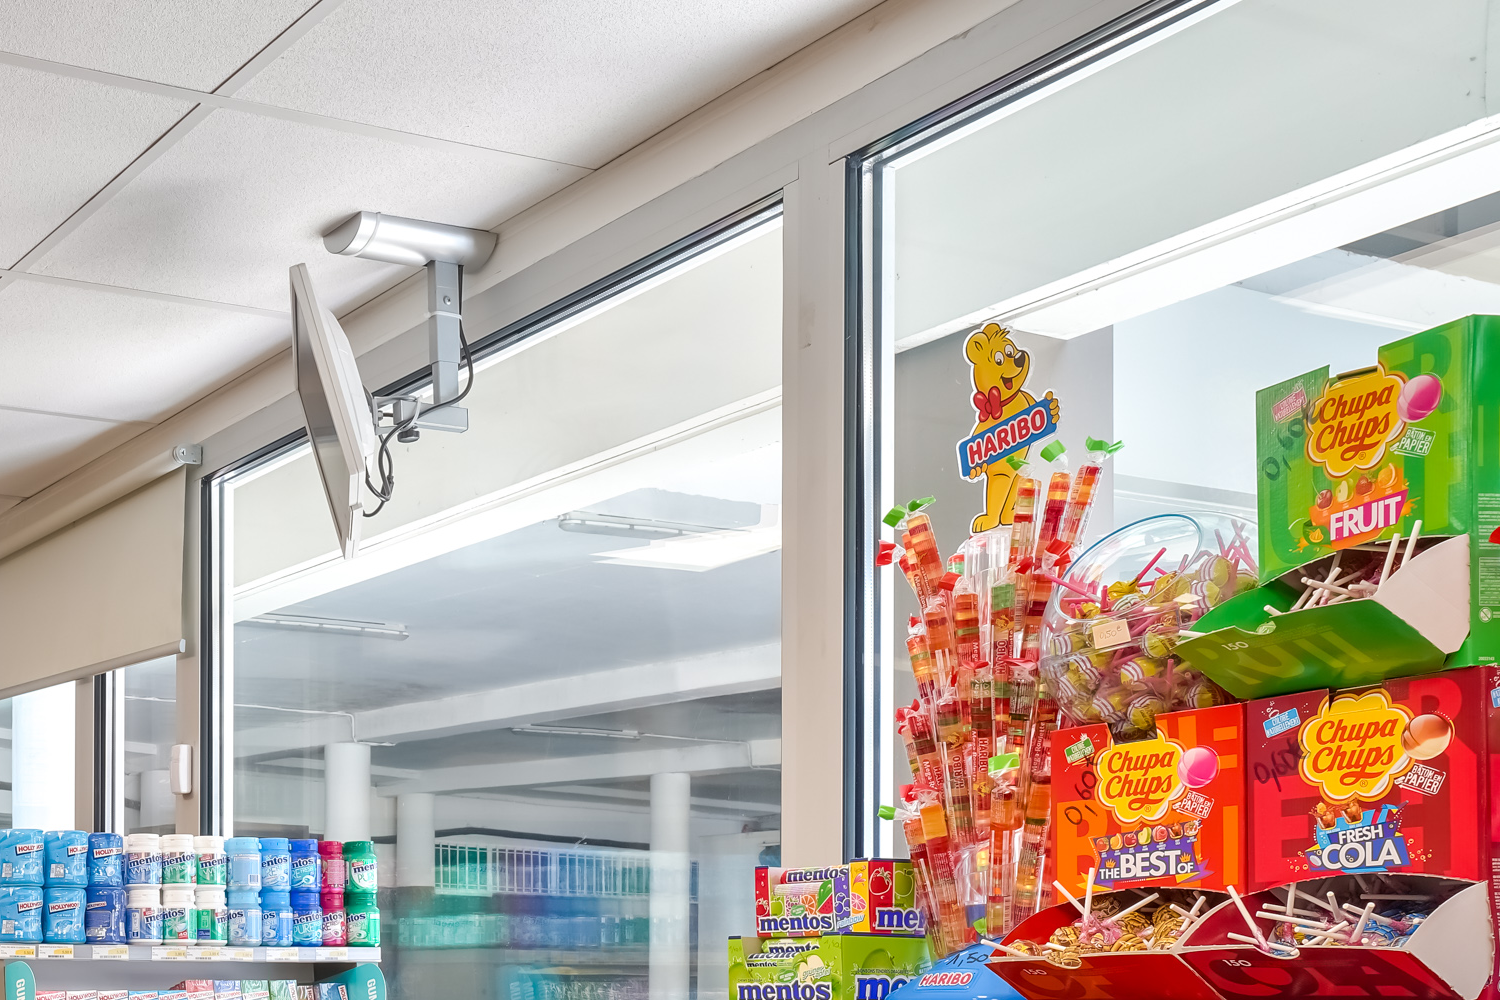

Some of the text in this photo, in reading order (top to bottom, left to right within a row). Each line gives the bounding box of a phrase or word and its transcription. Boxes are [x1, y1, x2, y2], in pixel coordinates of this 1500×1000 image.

[1321, 384, 1394, 420] Chupa
[967, 409, 1046, 465] HARIBO
[1315, 412, 1391, 461] Chups
[1401, 438, 1429, 454] PAPIER
[1330, 495, 1402, 540] FRUIT
[1316, 717, 1399, 747] Chupa
[1108, 751, 1175, 775] Chupa
[1312, 745, 1395, 785] Chups
[1105, 774, 1172, 810] Chups
[1406, 773, 1440, 793] PAPIER
[1339, 825, 1383, 844] FRESH
[1100, 850, 1194, 879] THE BEST OF
[1322, 839, 1401, 869] COLA
[787, 868, 848, 883] mentos
[760, 915, 832, 931] mentos
[1222, 958, 1251, 968] 150
[919, 973, 972, 986] HARIBO
